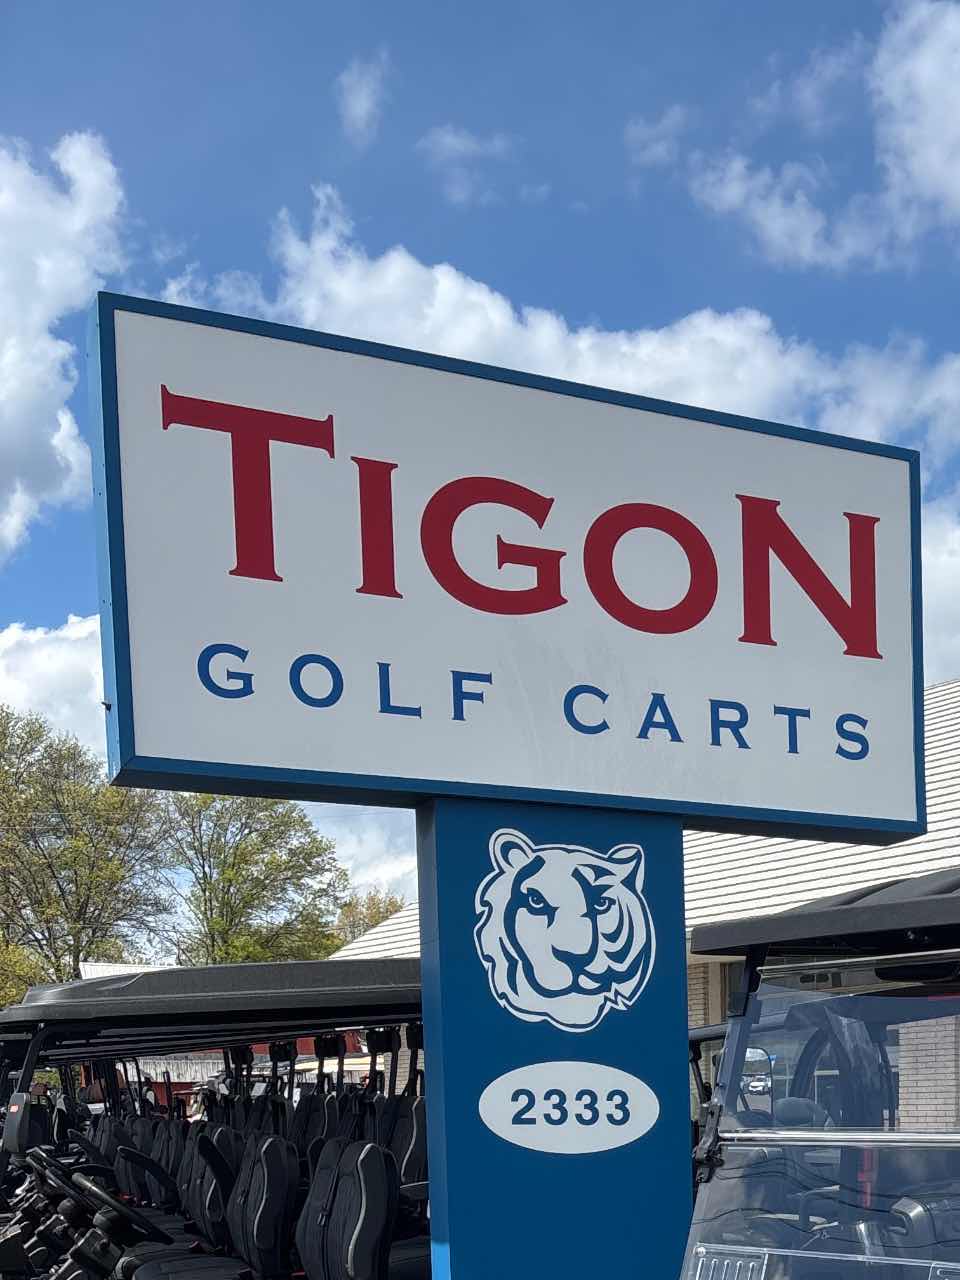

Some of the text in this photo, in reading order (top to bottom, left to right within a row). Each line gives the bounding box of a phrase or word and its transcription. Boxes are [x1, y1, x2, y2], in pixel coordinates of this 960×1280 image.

[161, 384, 883, 660] TIGON
[197, 643, 870, 761] GOLF CARTS
[510, 1088, 631, 1126] 2333
